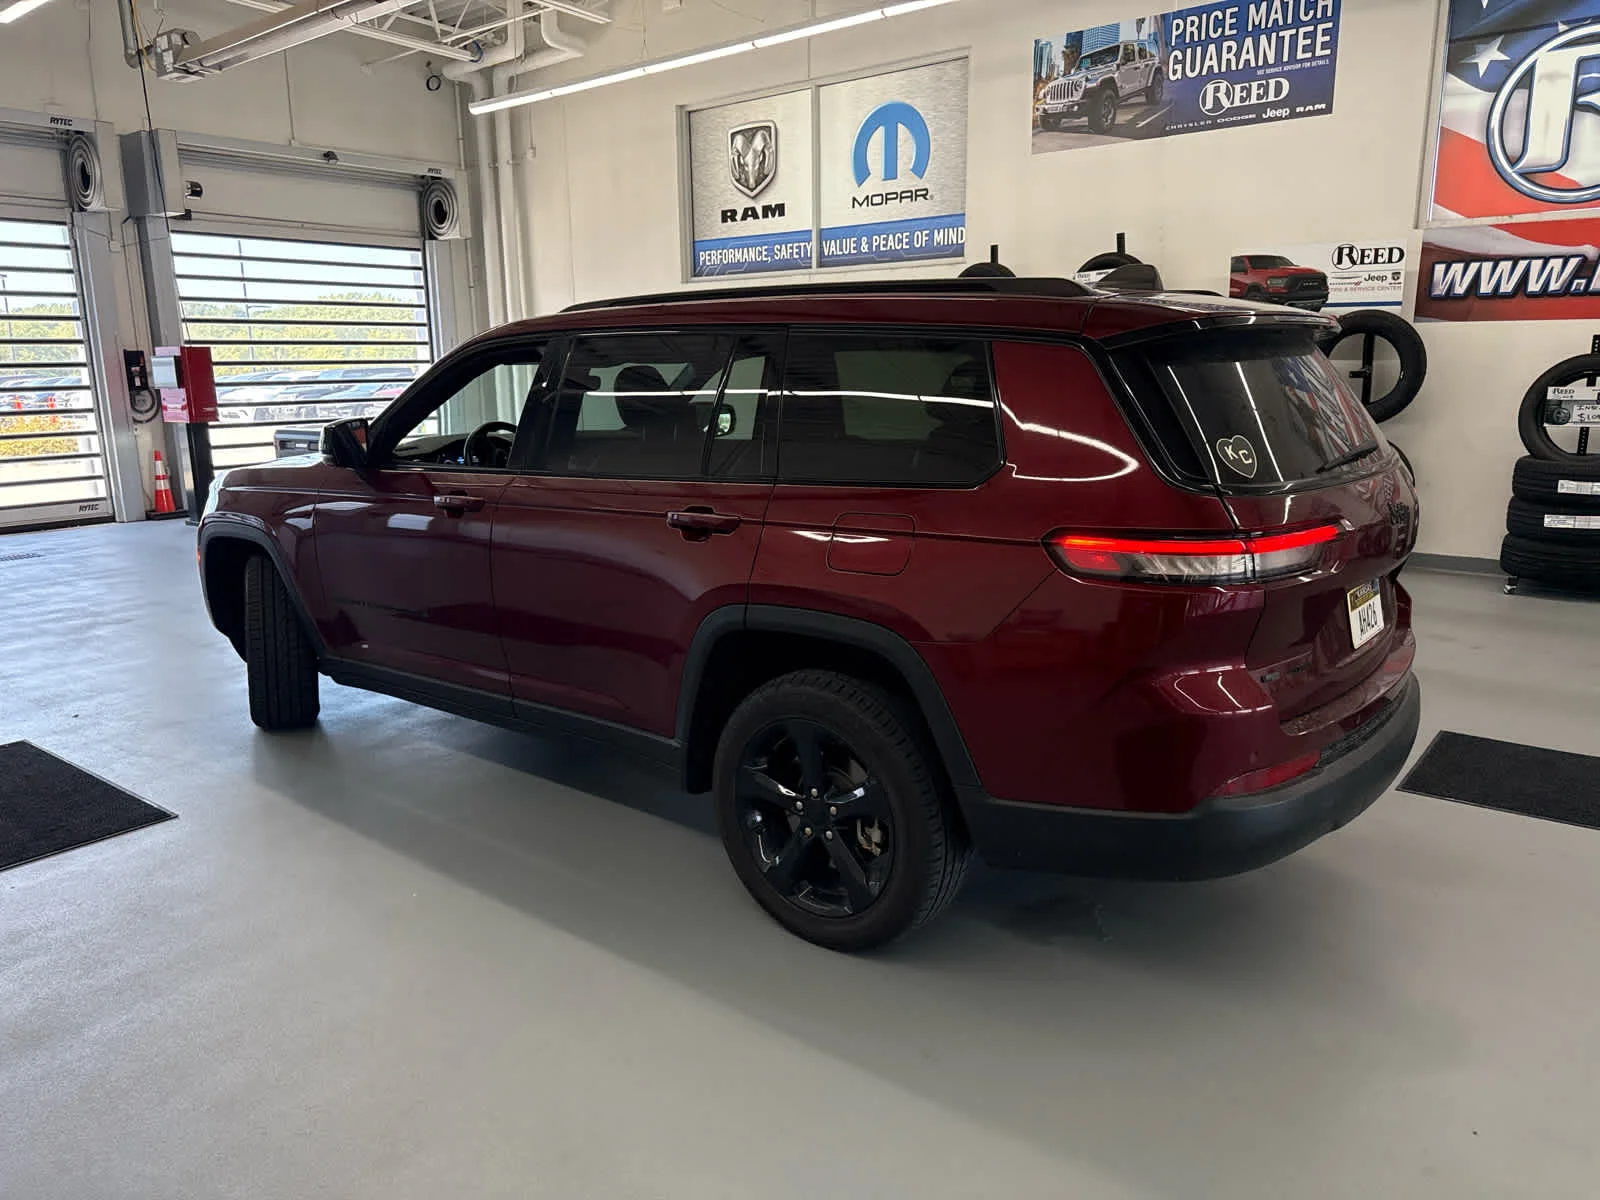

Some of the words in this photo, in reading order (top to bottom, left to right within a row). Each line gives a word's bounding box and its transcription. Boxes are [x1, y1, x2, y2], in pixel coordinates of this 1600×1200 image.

[1171, 7, 1239, 46] PRICE
[1247, 0, 1333, 32] MATCH
[1168, 22, 1334, 80] GUARANTEE
[1202, 77, 1290, 113] REED
[1165, 120, 1213, 131] CHRYSLER
[1216, 113, 1257, 124] DODGE
[1262, 107, 1290, 119] Jeep
[1295, 103, 1327, 113] RAM
[851, 187, 931, 209] MOPAR
[720, 203, 786, 224] RAM
[699, 245, 771, 266] PERFORMANCE,
[773, 241, 813, 260] SAFETY
[822, 237, 857, 257] VALUE
[860, 237, 869, 253] &
[872, 231, 910, 252] PEACE
[914, 230, 929, 248] OF
[933, 227, 966, 247] MIND
[1334, 245, 1405, 268] REED
[1363, 273, 1388, 283] Jeep
